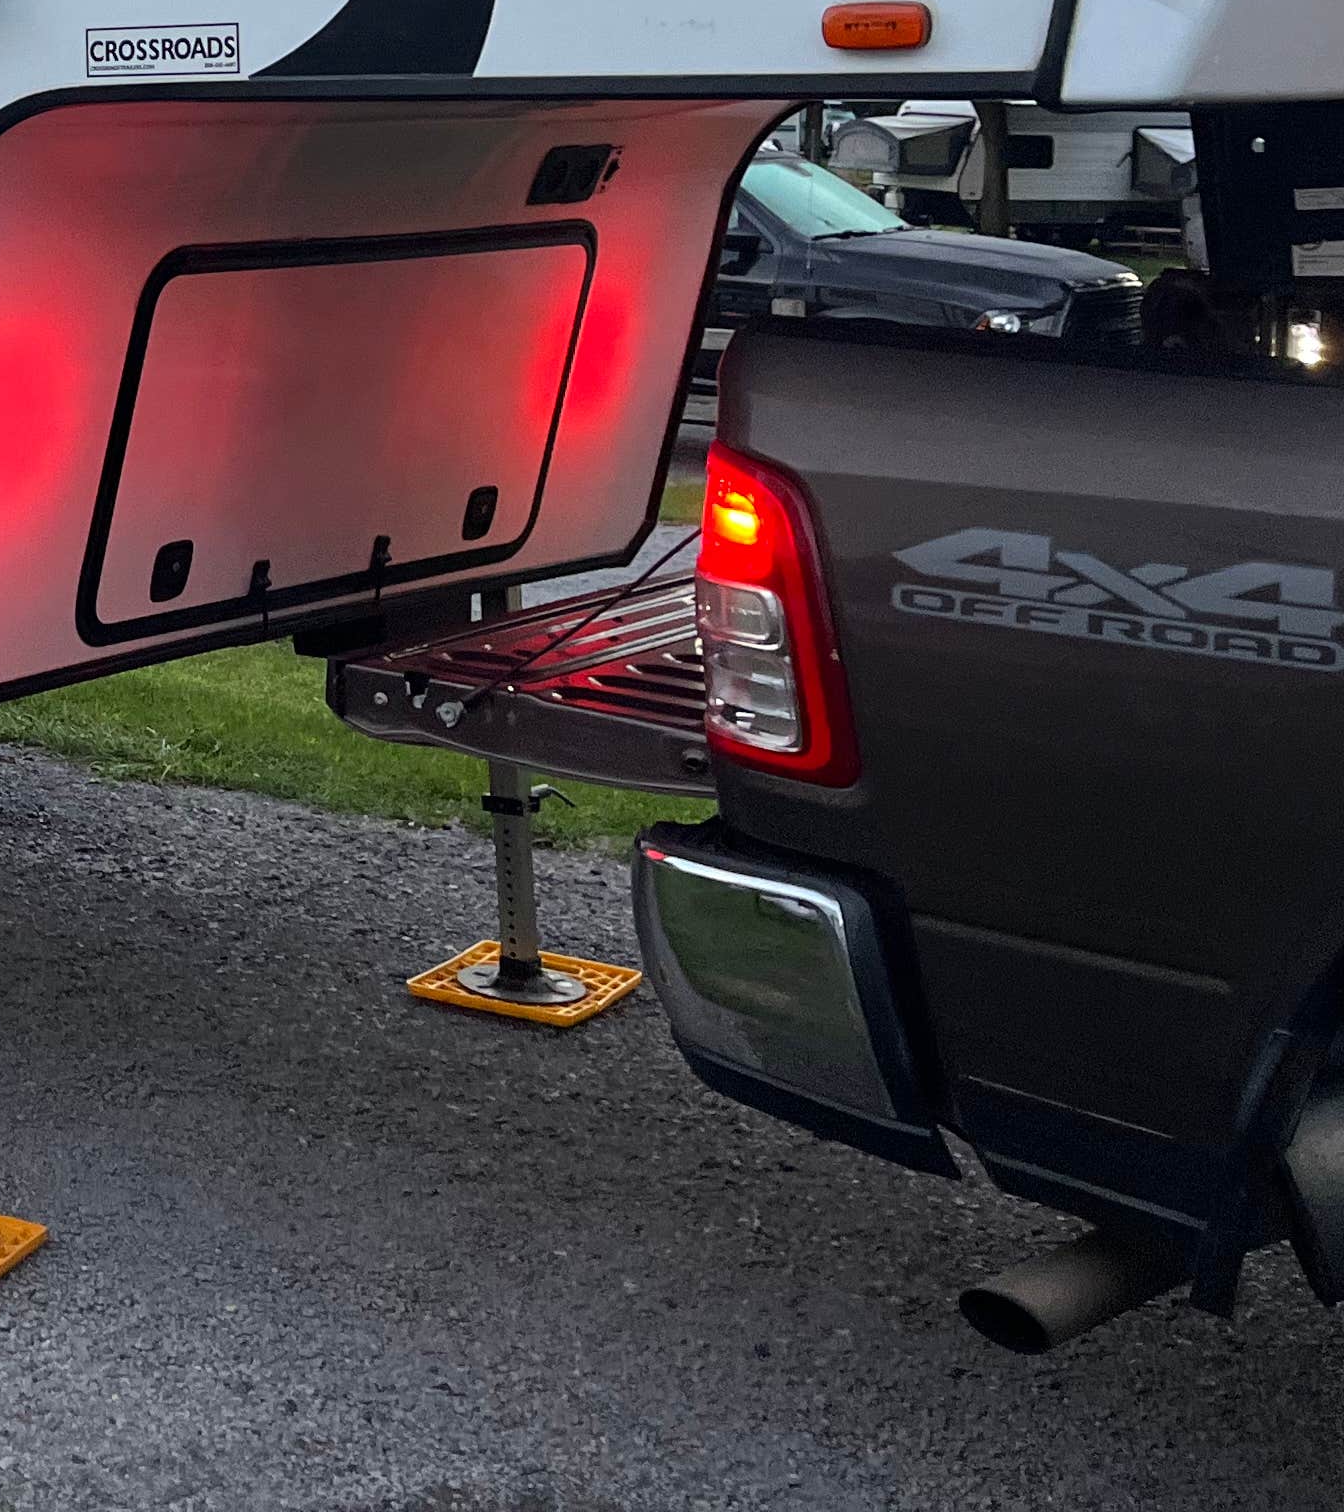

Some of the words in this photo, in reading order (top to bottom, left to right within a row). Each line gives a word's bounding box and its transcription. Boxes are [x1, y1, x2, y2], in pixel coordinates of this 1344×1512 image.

[89, 36, 236, 62] CROSSROADS
[899, 587, 1067, 626] OFF
[1087, 613, 1338, 666] ROAD
